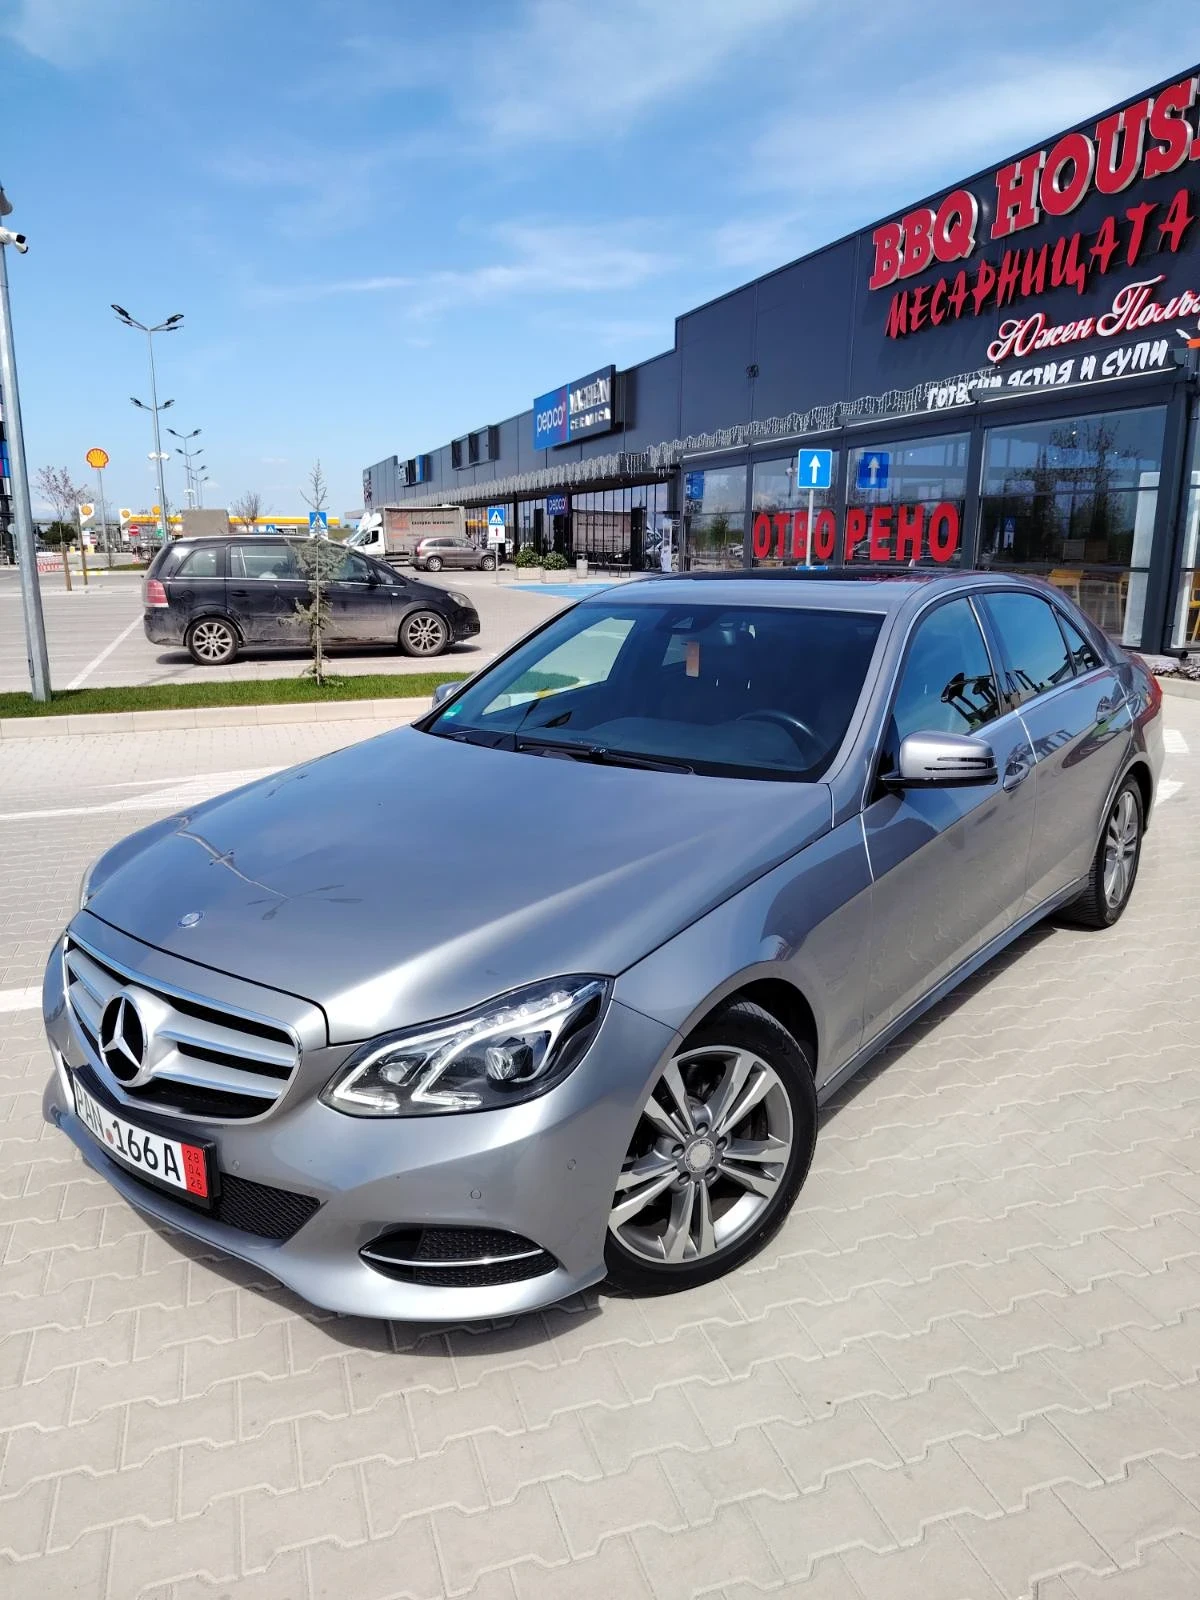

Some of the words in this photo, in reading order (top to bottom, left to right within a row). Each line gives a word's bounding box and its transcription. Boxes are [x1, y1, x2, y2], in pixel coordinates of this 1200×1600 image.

[870, 190, 978, 290] BBQ
[991, 75, 1200, 239] HOUS
[885, 189, 1195, 339] МЕСАРНИЦАТА
[987, 312, 1096, 363] Южен
[536, 403, 565, 437] pepco
